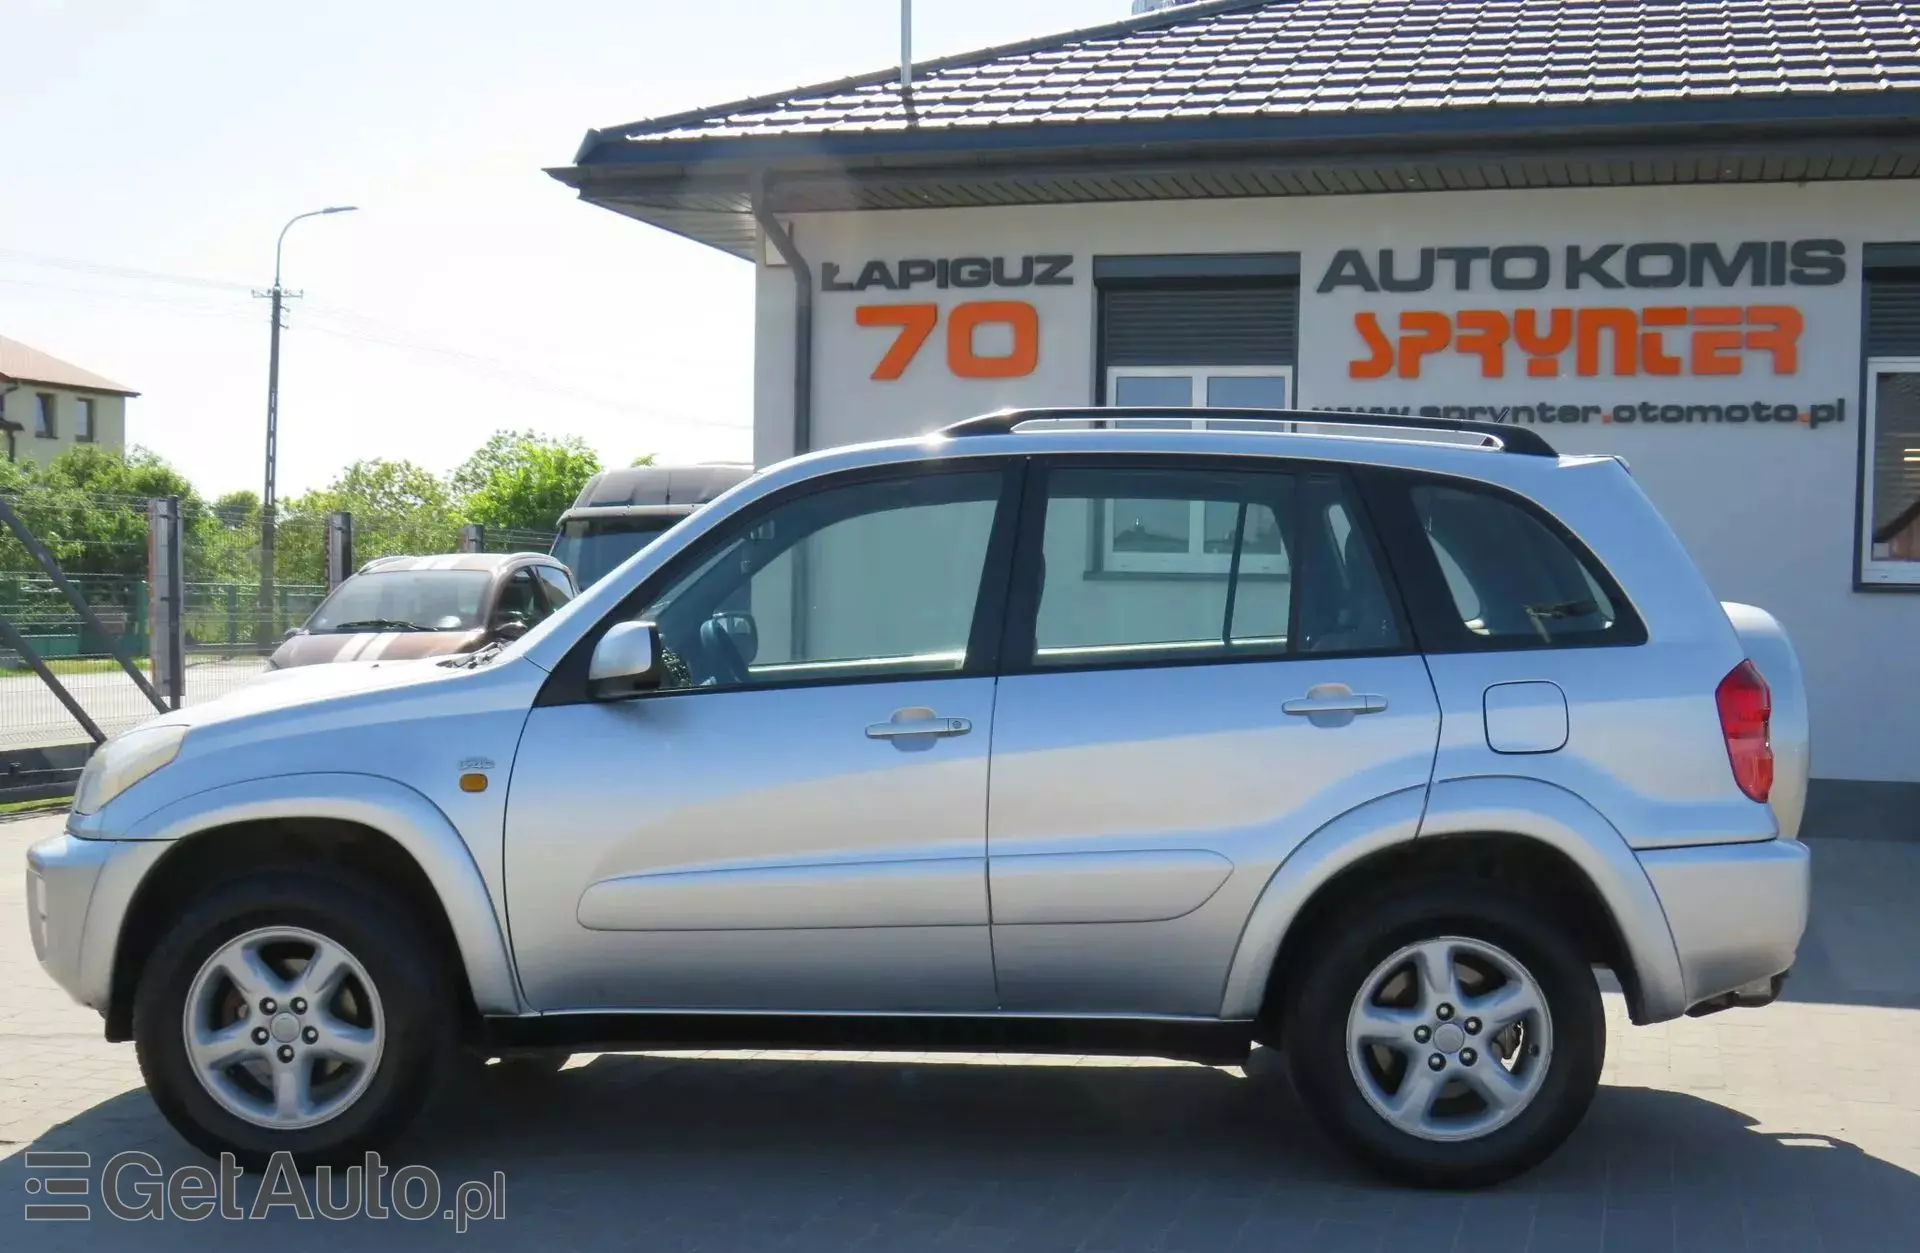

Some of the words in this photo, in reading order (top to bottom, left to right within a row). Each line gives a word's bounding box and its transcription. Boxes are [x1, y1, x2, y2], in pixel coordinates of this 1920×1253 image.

[821, 254, 1074, 292] ŁAPIGUZ
[1316, 245, 1550, 293] AUTO
[1565, 238, 1846, 290] KOMIS
[855, 300, 1038, 381] 70
[1311, 398, 1845, 429] sprynter.otomoto.pl
